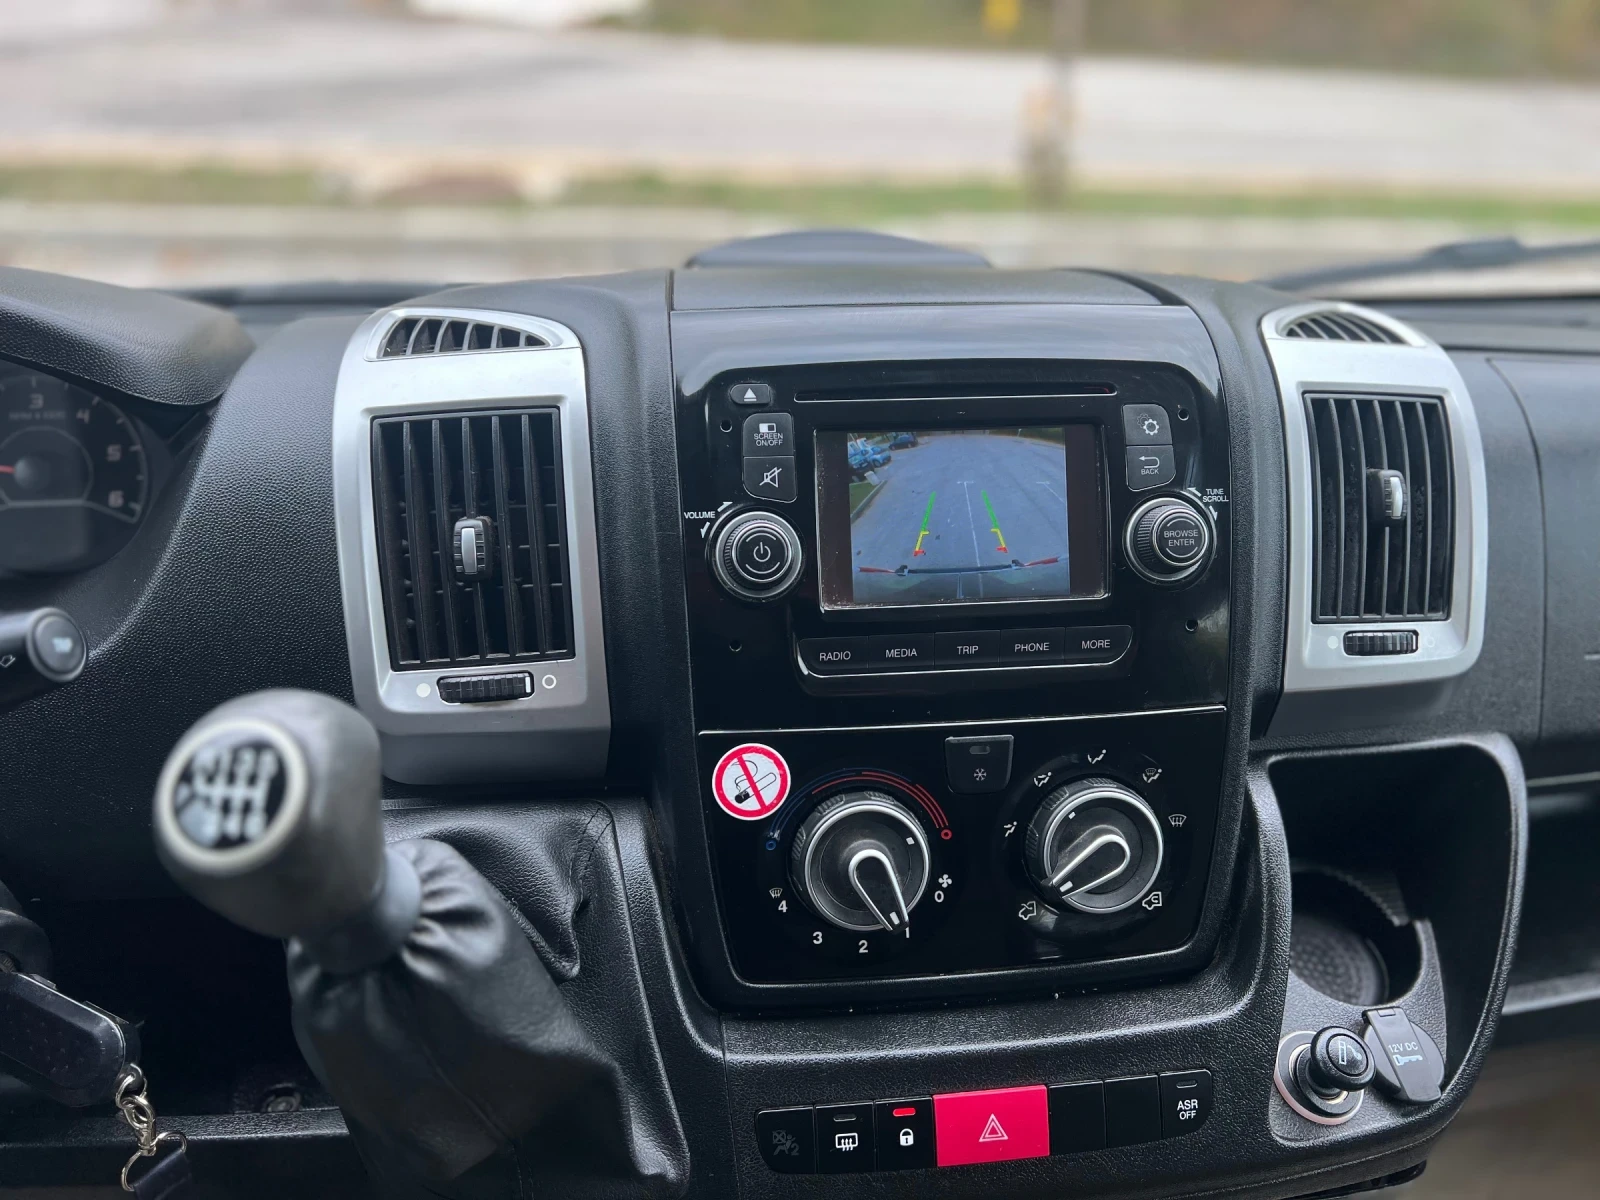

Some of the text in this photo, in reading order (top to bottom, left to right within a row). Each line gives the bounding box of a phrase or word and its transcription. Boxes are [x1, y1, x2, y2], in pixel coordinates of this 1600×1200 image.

[76, 408, 90, 423] 4
[684, 511, 716, 519] VOLUME
[1164, 530, 1199, 538] BROWSE
[1168, 538, 1195, 547] ENTER
[957, 645, 979, 655] TRIP
[1014, 642, 1050, 653] PHONE
[1081, 639, 1111, 650] MORE
[819, 651, 851, 661] RADIO
[885, 648, 918, 658] MEDIA
[778, 900, 788, 913] 4
[812, 931, 823, 945] 3
[858, 940, 869, 953] 2
[1388, 1041, 1418, 1053] 12V DC
[1177, 1099, 1199, 1111] ASR
[1179, 1110, 1197, 1120] OFF
